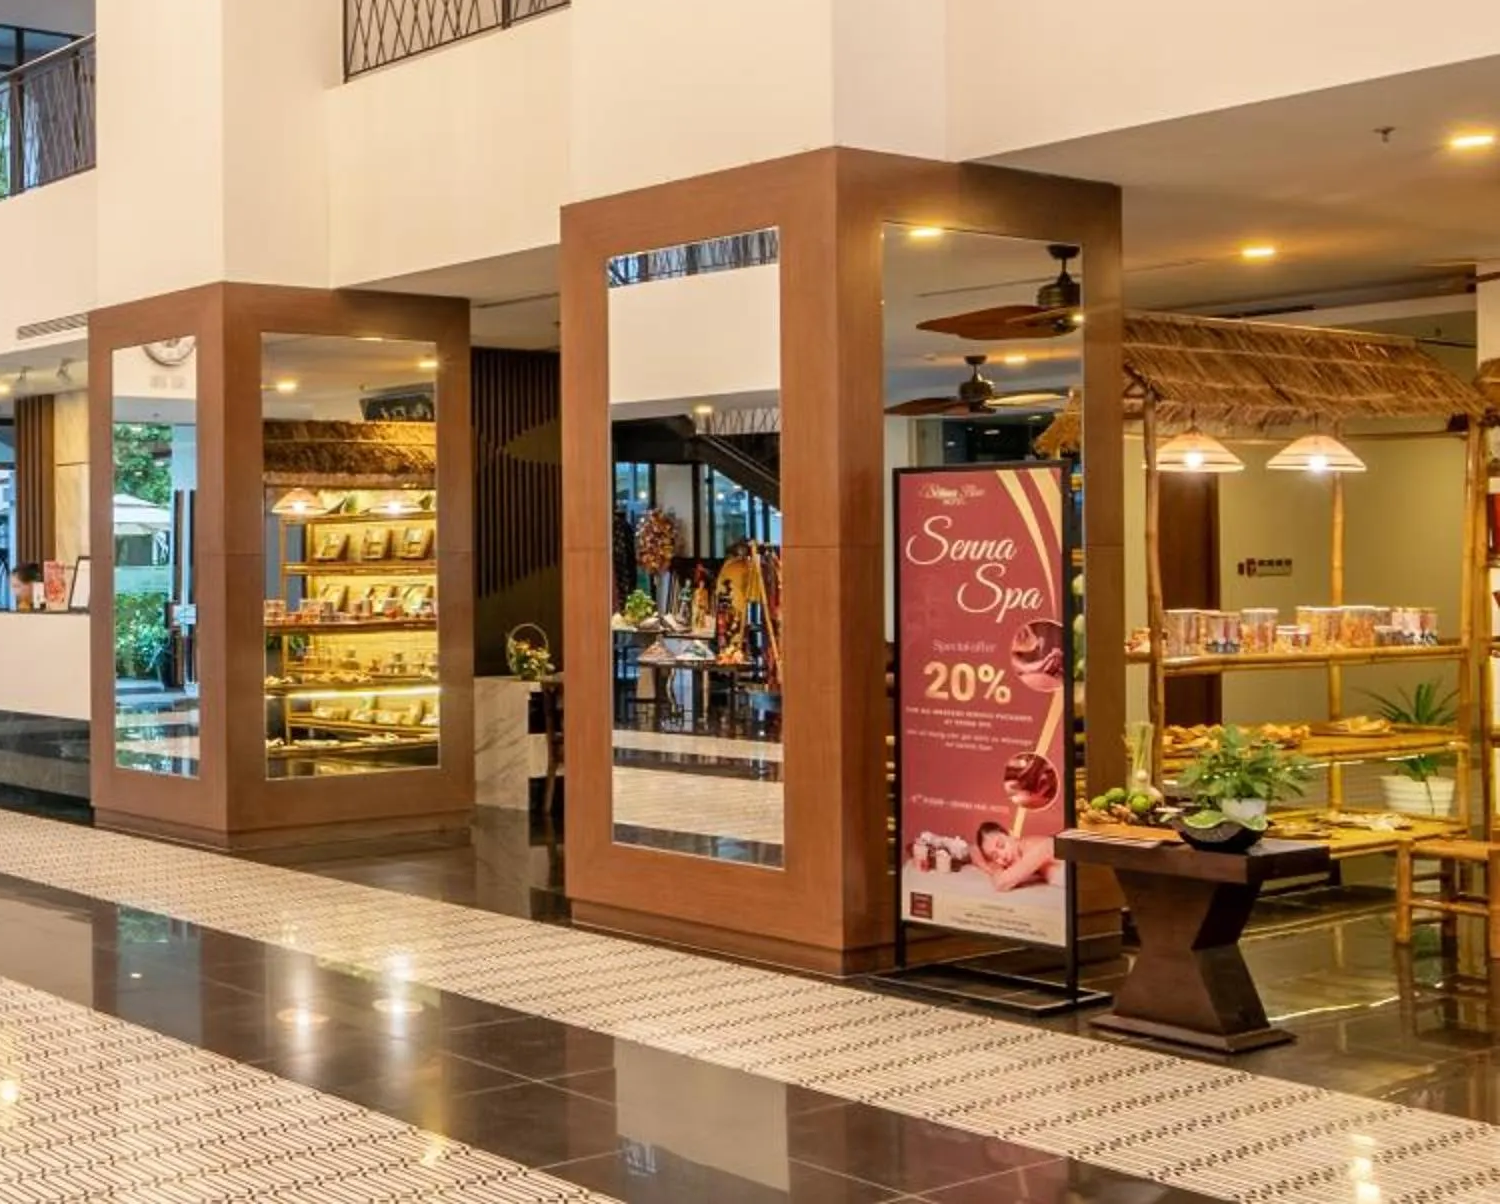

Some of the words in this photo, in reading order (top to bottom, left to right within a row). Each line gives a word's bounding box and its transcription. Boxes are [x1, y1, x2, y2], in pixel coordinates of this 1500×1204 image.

[905, 515, 1017, 565] Senna
[957, 563, 1045, 623] Spa
[924, 661, 1011, 704] 20%
